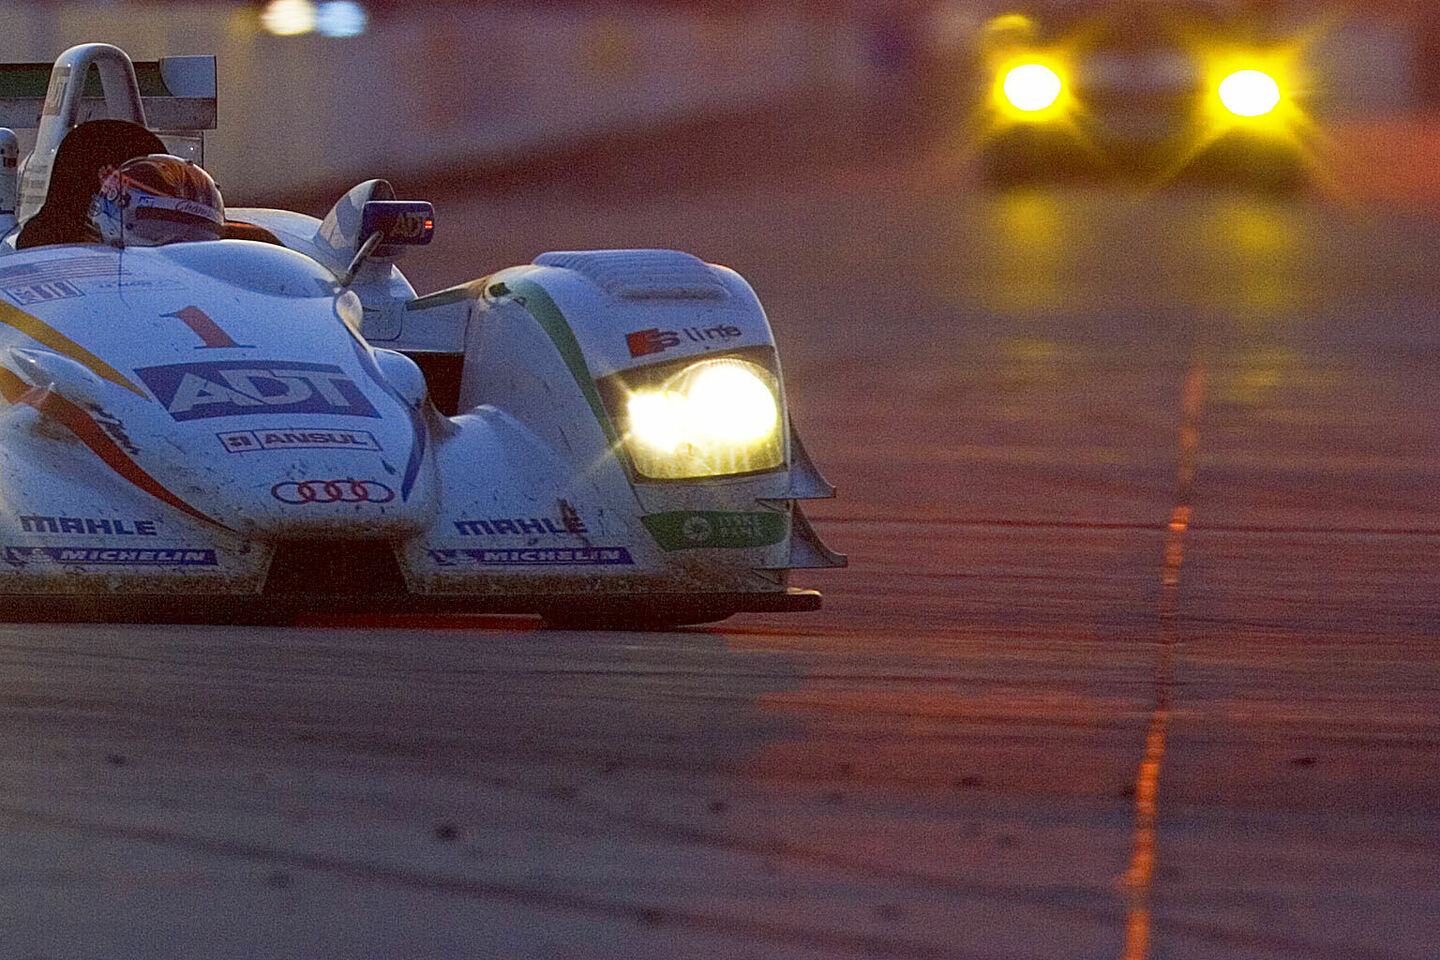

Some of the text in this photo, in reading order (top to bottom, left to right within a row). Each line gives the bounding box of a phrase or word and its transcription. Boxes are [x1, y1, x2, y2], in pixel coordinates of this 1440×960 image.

[159, 305, 256, 349] 1
[683, 325, 743, 341] line
[168, 368, 353, 413] ADT
[264, 432, 368, 446] ANSUL
[20, 515, 158, 536] MAHLE
[60, 549, 207, 562] MICHELIN
[484, 550, 621, 562] MICHELIN
